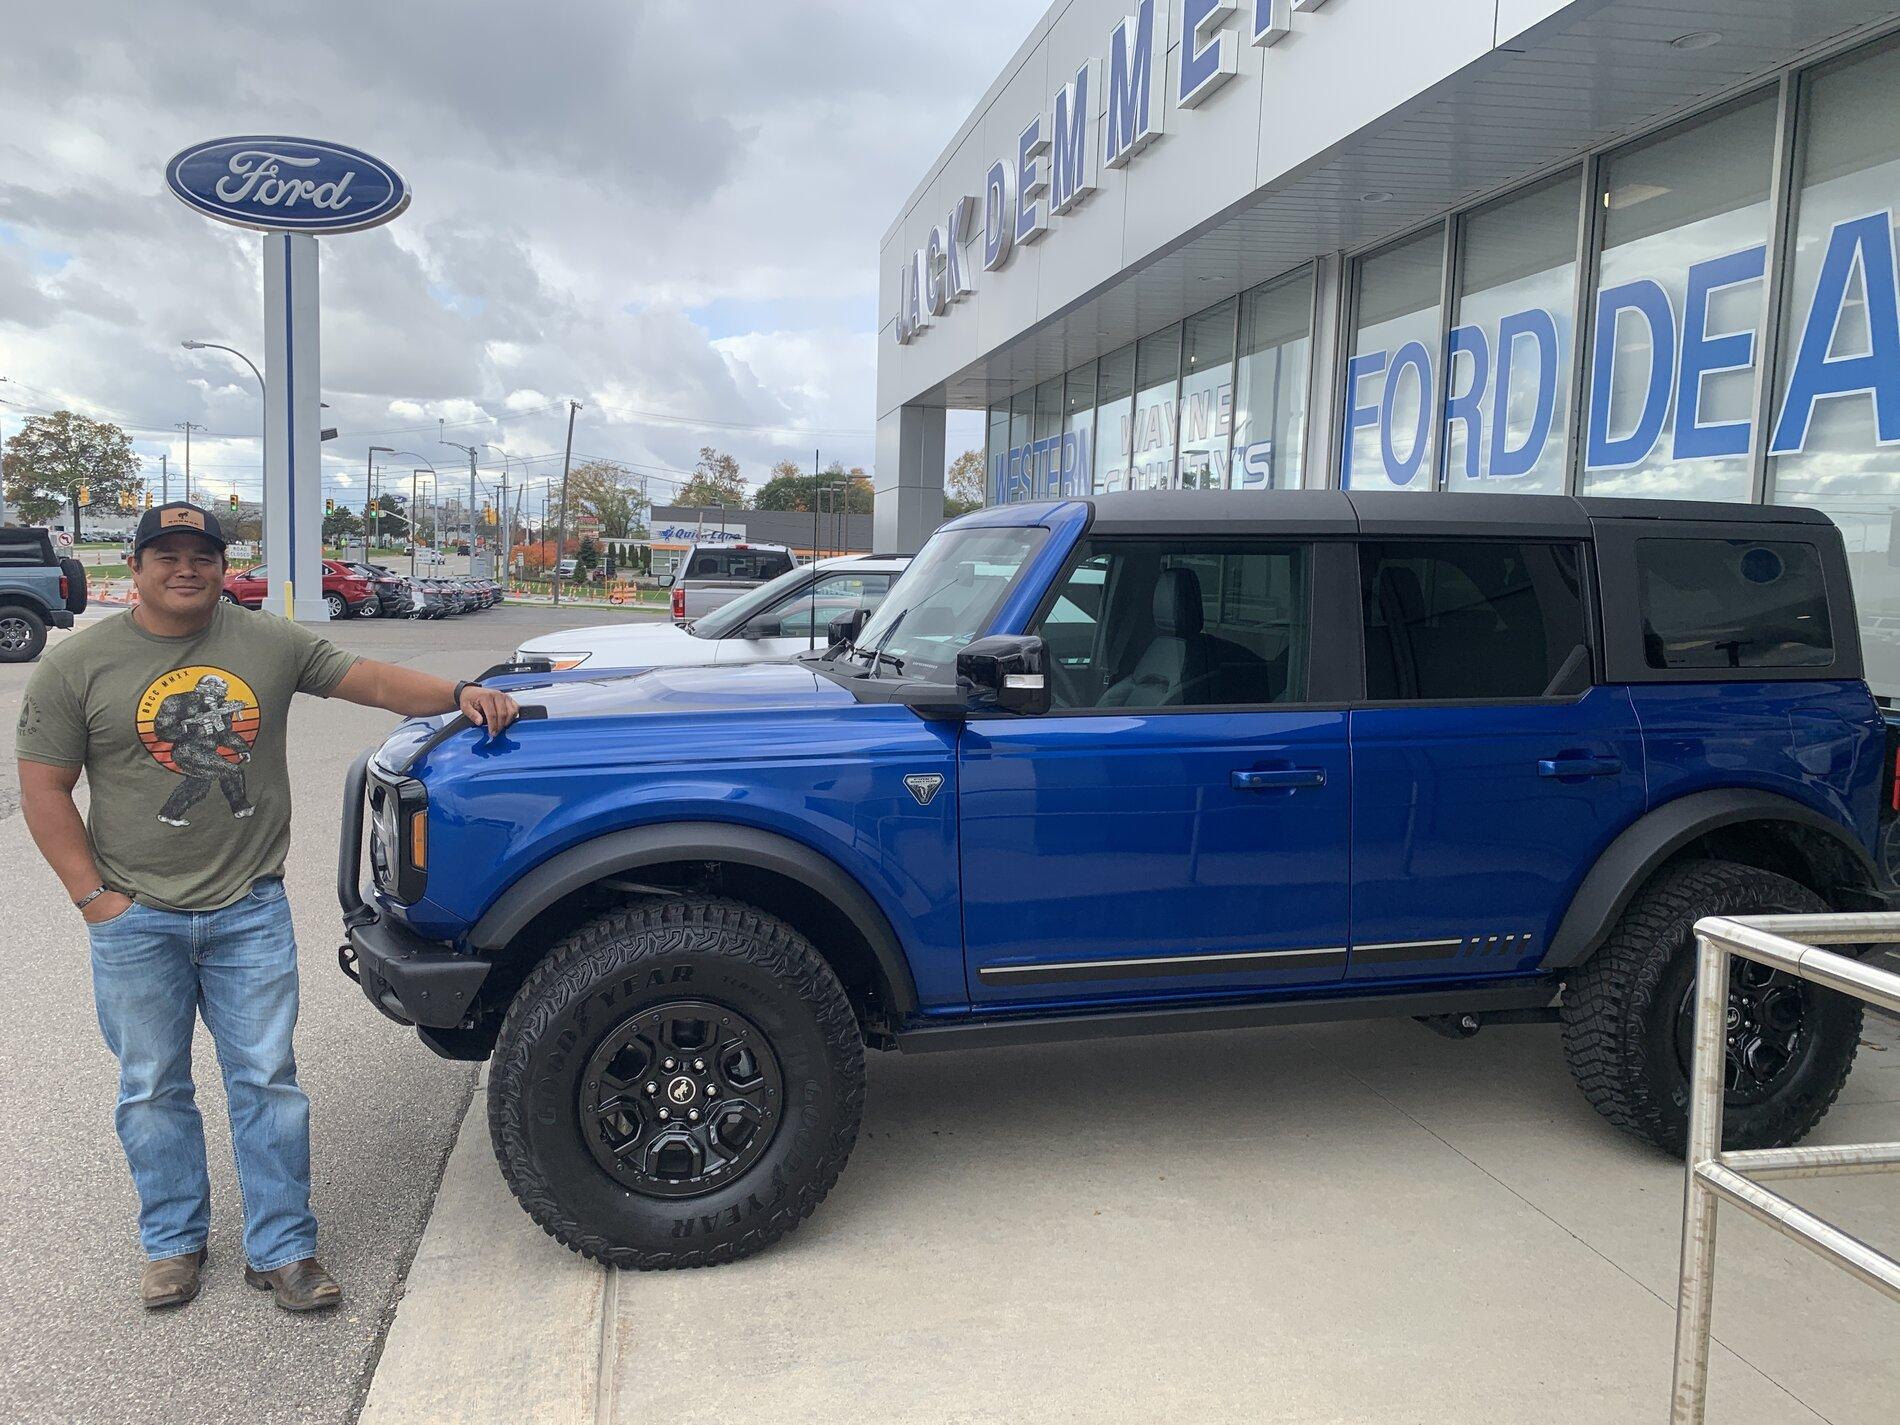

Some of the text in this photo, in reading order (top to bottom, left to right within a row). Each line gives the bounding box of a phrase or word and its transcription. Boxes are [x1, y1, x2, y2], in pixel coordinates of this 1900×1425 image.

[216, 151, 355, 210] Ford
[895, 0, 1330, 344] JACK DEMME
[1121, 383, 1233, 456] WAYNE
[1340, 308, 1560, 492] FORD
[995, 427, 1095, 504] WESTERN
[161, 670, 190, 688] MMXX
[602, 964, 695, 1010] YEAR
